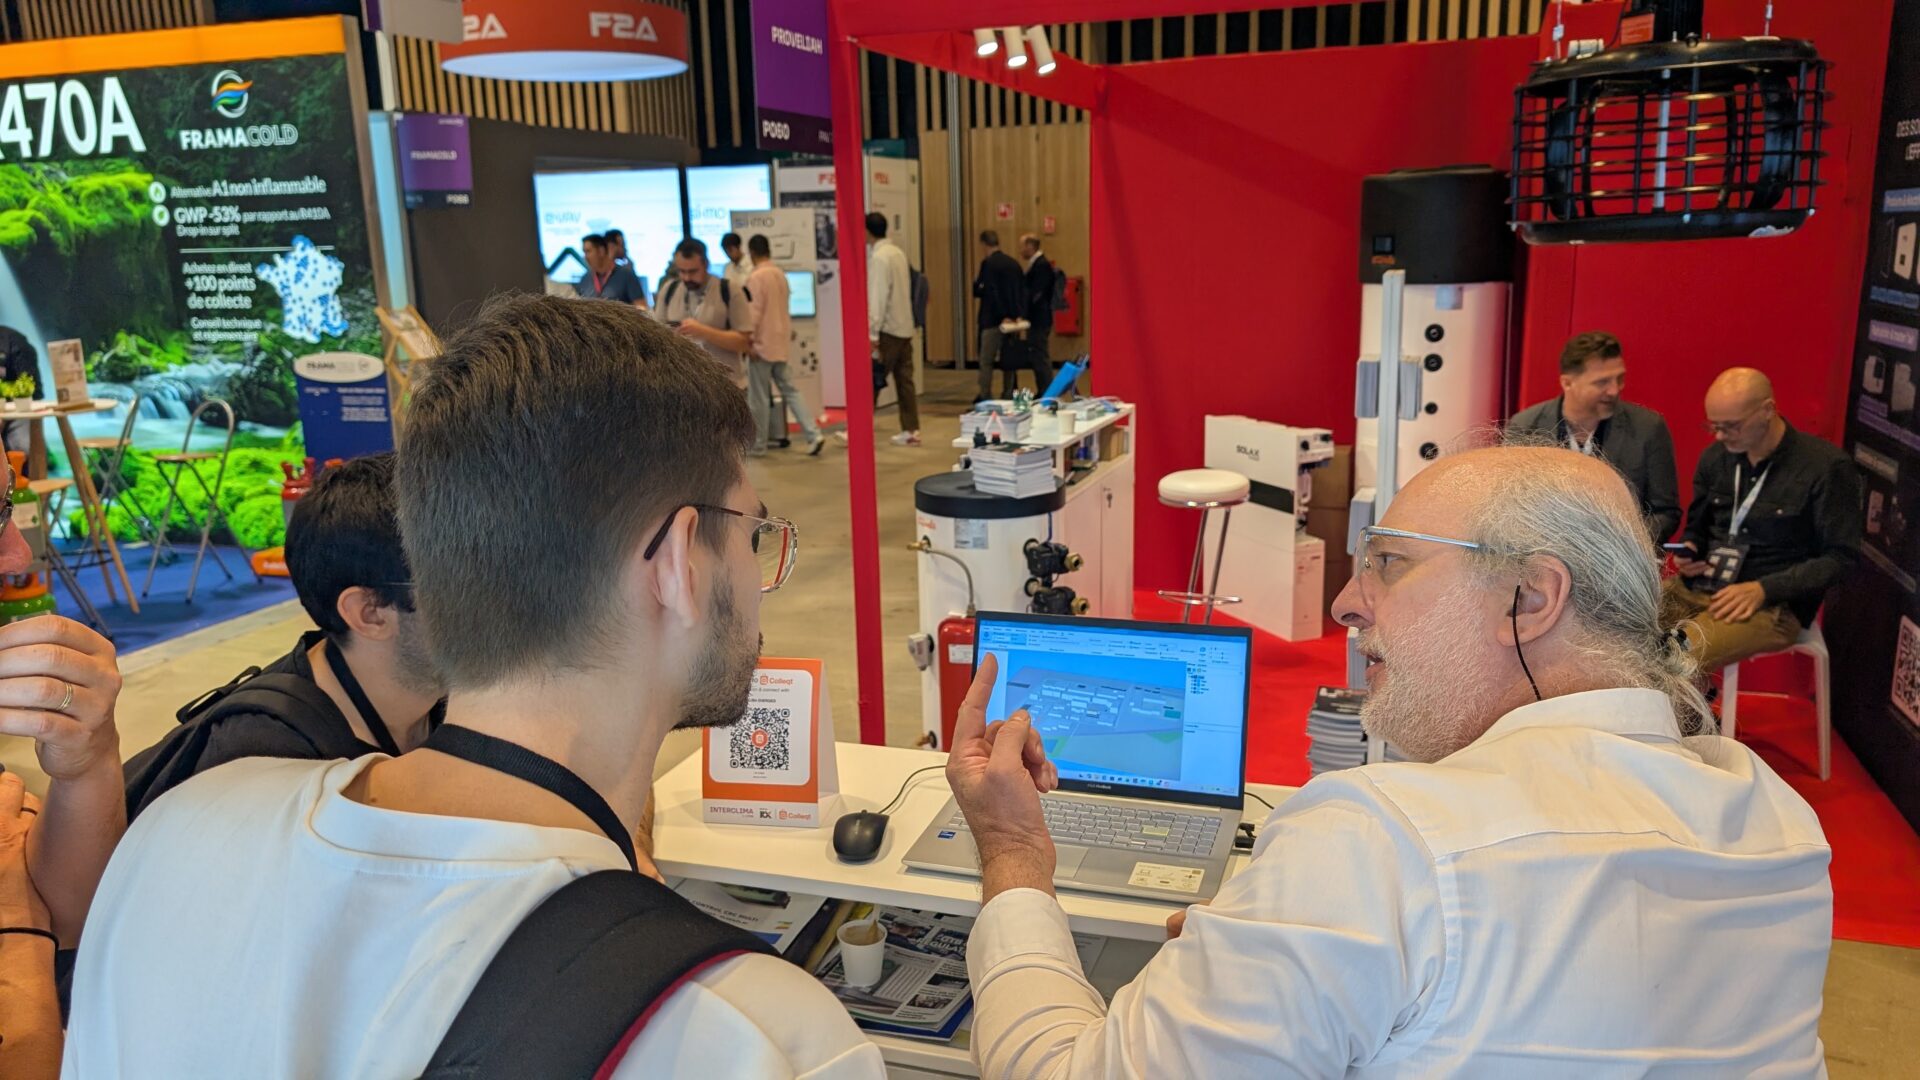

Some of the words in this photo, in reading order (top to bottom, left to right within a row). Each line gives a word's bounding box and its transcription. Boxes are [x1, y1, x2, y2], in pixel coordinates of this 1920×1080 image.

[463, 12, 508, 41] 2A
[588, 11, 658, 42] F2A
[771, 26, 823, 55] PROVELIAH
[0, 76, 147, 159] 470A
[179, 123, 299, 150] FRAMACOLD
[212, 179, 229, 197] A1
[229, 183, 252, 196] non
[252, 175, 327, 195] inflammable
[173, 206, 208, 224] GWP
[208, 205, 242, 223] -53%
[184, 274, 217, 292] +100
[218, 274, 256, 293] points
[187, 291, 204, 309] de
[205, 292, 252, 309] collecte
[710, 806, 754, 814] INTERCLIMA
